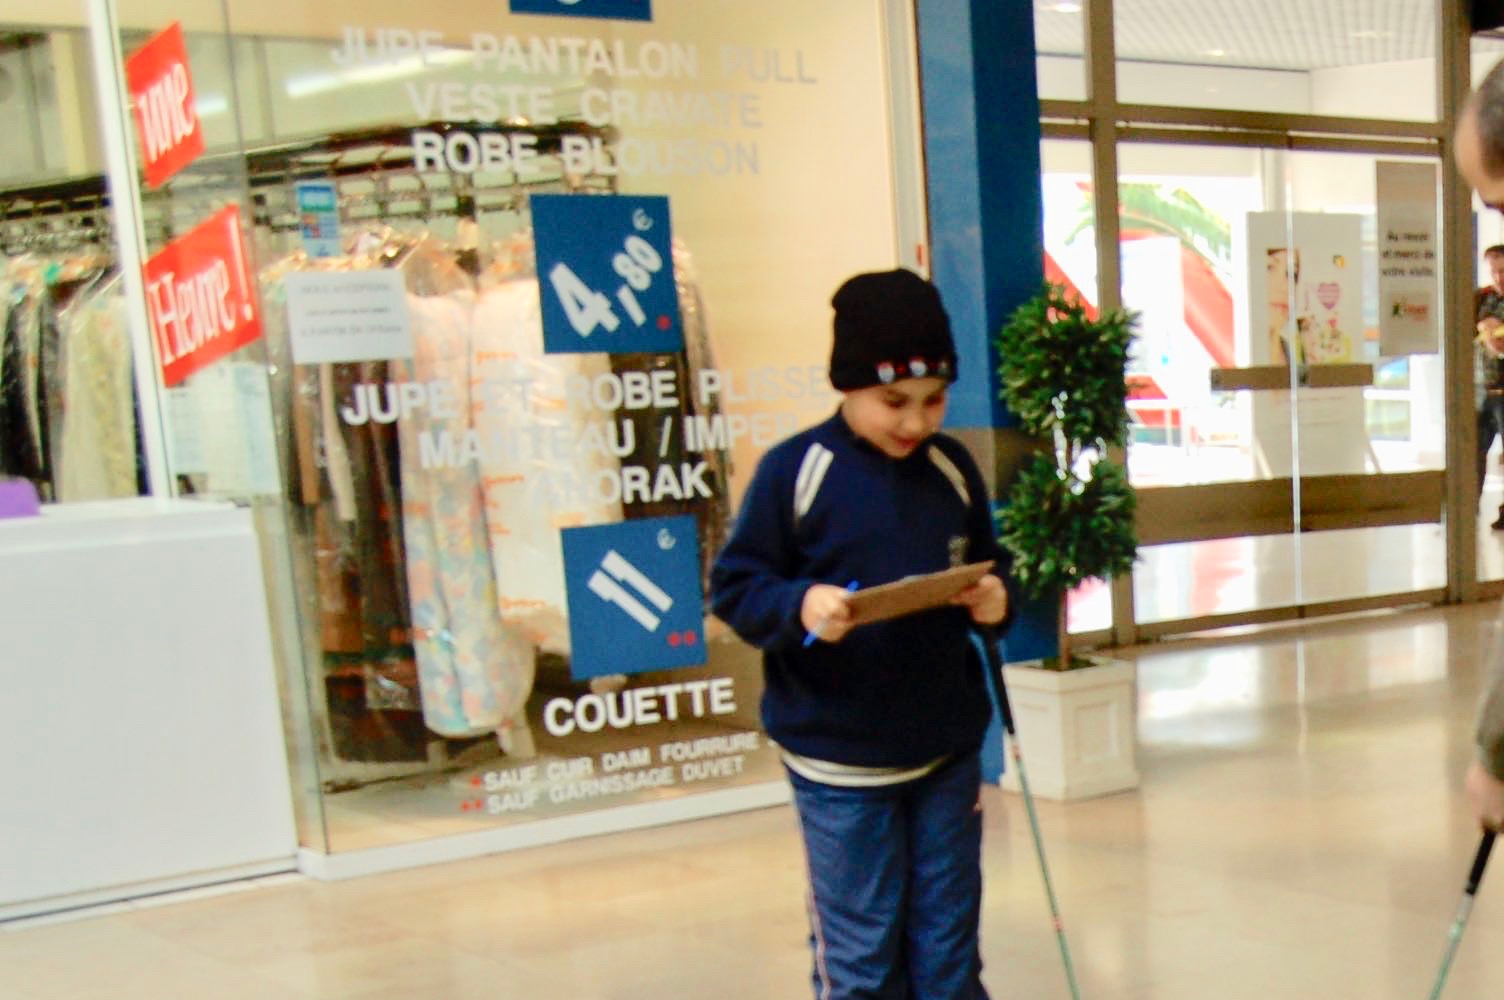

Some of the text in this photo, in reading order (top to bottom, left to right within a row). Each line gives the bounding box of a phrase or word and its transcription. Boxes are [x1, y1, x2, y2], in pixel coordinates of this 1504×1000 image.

[331, 26, 817, 84] JUPE PANTALON PULL
[406, 82, 763, 129] VESTE CRAVATE
[412, 131, 760, 177] ROBE BLOUSON
[342, 382, 457, 426] JUPE
[566, 370, 680, 411] ROBE
[418, 418, 636, 469] MANTEAU
[529, 461, 713, 507] ANORAK
[543, 677, 736, 736] COUETTE
[484, 766, 538, 791] SAUF
[546, 756, 593, 780] CUIR
[602, 747, 652, 772] DAIM
[488, 789, 539, 814] SAUF
[682, 755, 745, 782] DUVET
